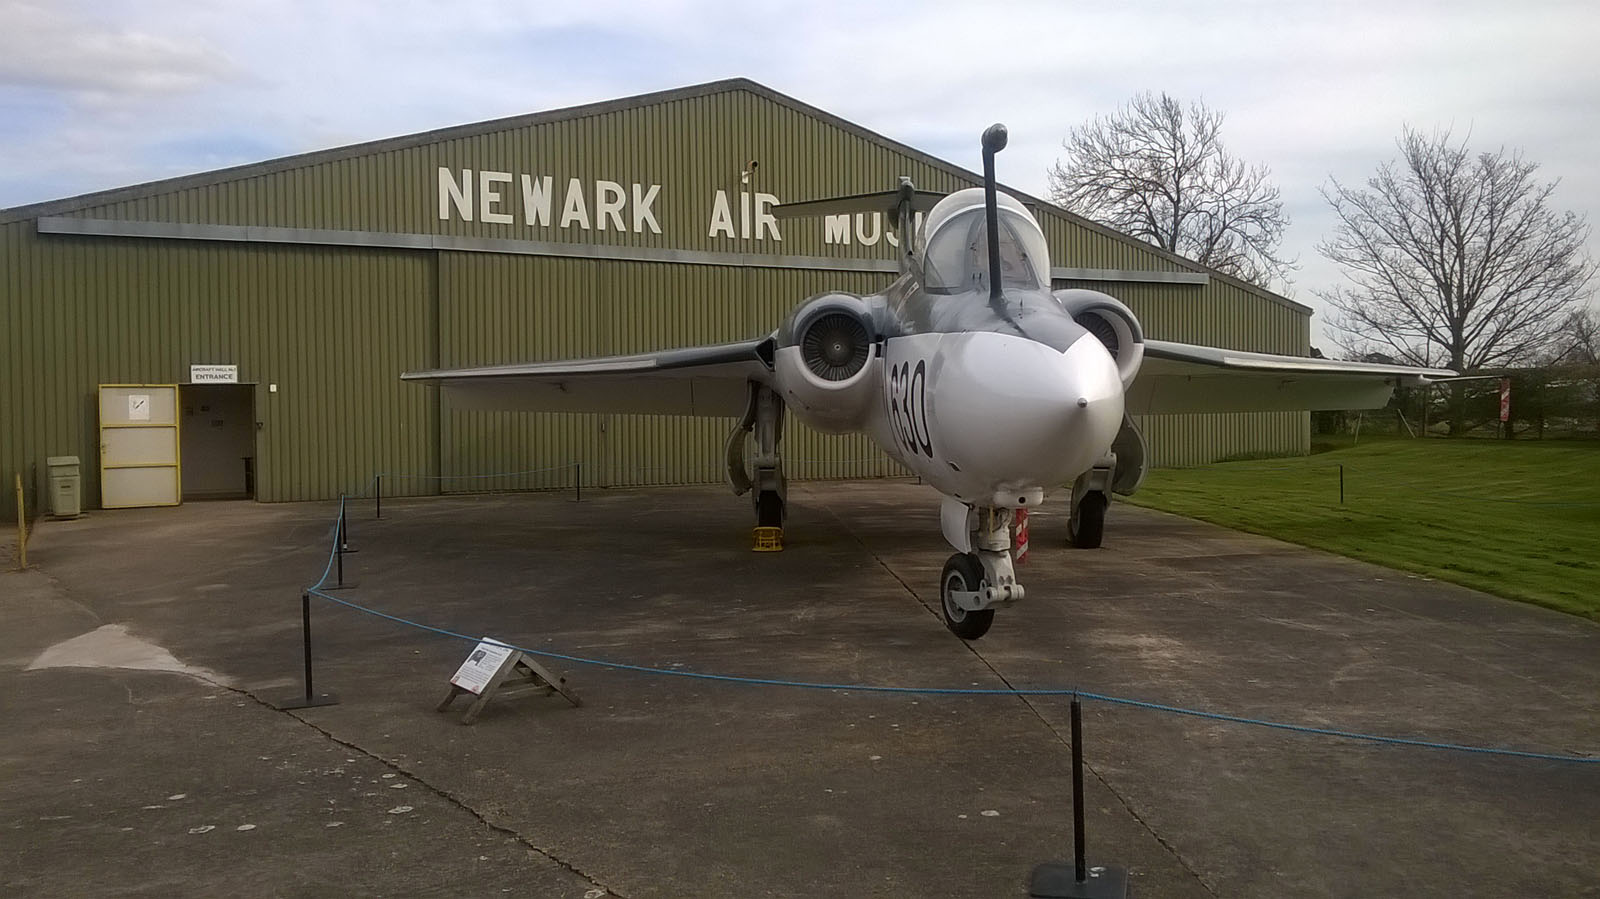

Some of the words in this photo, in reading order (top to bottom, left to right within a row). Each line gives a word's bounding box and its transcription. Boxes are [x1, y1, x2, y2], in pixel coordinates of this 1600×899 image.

[438, 166, 663, 235] NEWARK
[708, 189, 783, 241] AIR
[890, 359, 934, 459] 630
